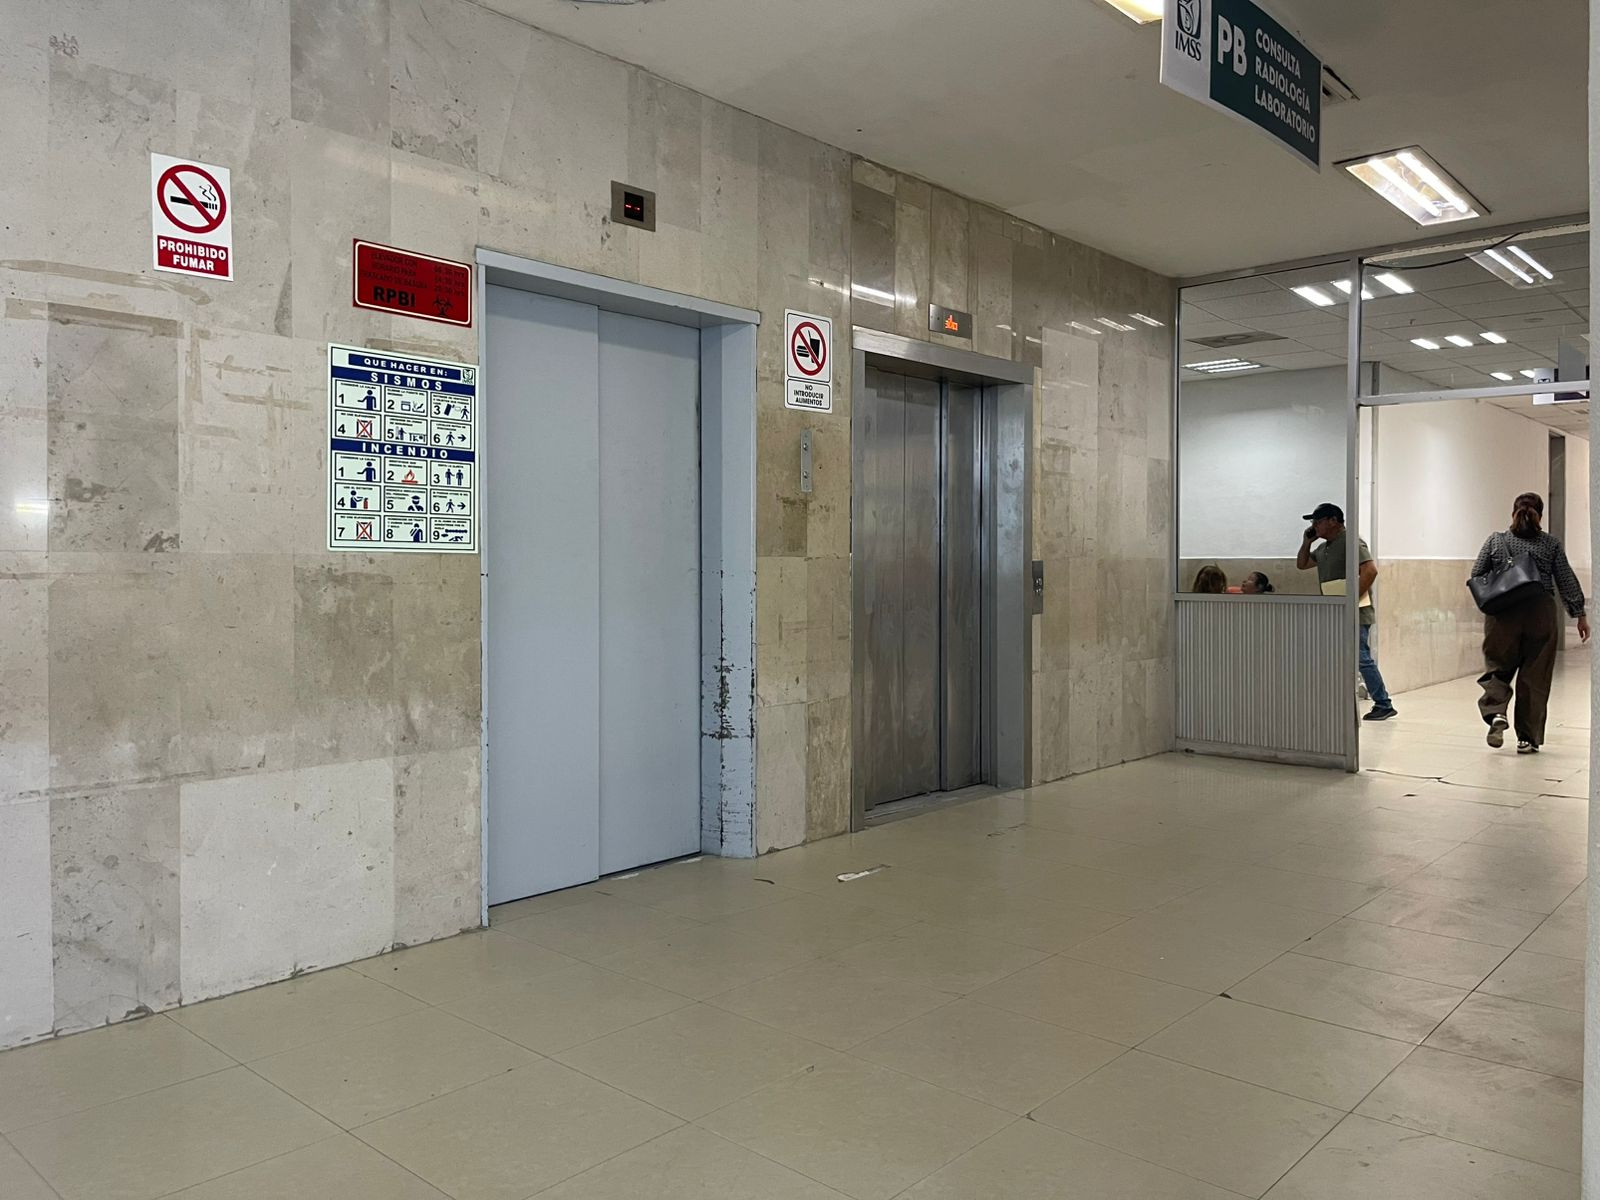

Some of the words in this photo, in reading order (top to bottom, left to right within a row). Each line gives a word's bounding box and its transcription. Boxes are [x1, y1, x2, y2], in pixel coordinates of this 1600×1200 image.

[1175, 30, 1202, 61] IMSS
[1217, 14, 1248, 76] PB
[1255, 28, 1301, 79] CONSULTA
[1255, 56, 1311, 115] RADIOLOGÍA
[1255, 85, 1316, 143] LABORATORIO
[160, 239, 227, 260] PROHIBIDO
[173, 255, 214, 271] FUMAR
[373, 286, 415, 308] RPBI
[364, 358, 387, 368] QUE
[390, 360, 427, 374] HACER
[430, 367, 448, 377] EN:
[371, 372, 442, 391] SISMOS
[338, 393, 345, 404] 1
[794, 390, 824, 399] INTRODUCIR
[387, 400, 395, 410] 2
[795, 397, 822, 406] ALIMENTOS
[433, 405, 441, 415] 3
[337, 424, 346, 434] 4
[387, 429, 394, 439] 5
[433, 434, 441, 443] 6
[362, 442, 448, 459] INCENDIO
[338, 467, 344, 477] 1
[387, 470, 395, 480] 2
[433, 474, 441, 484] 3
[337, 497, 346, 507] 4
[386, 500, 394, 510] 5
[433, 502, 440, 512] 6
[337, 527, 345, 537] 7
[386, 529, 394, 539] 8
[433, 530, 440, 540] 9
